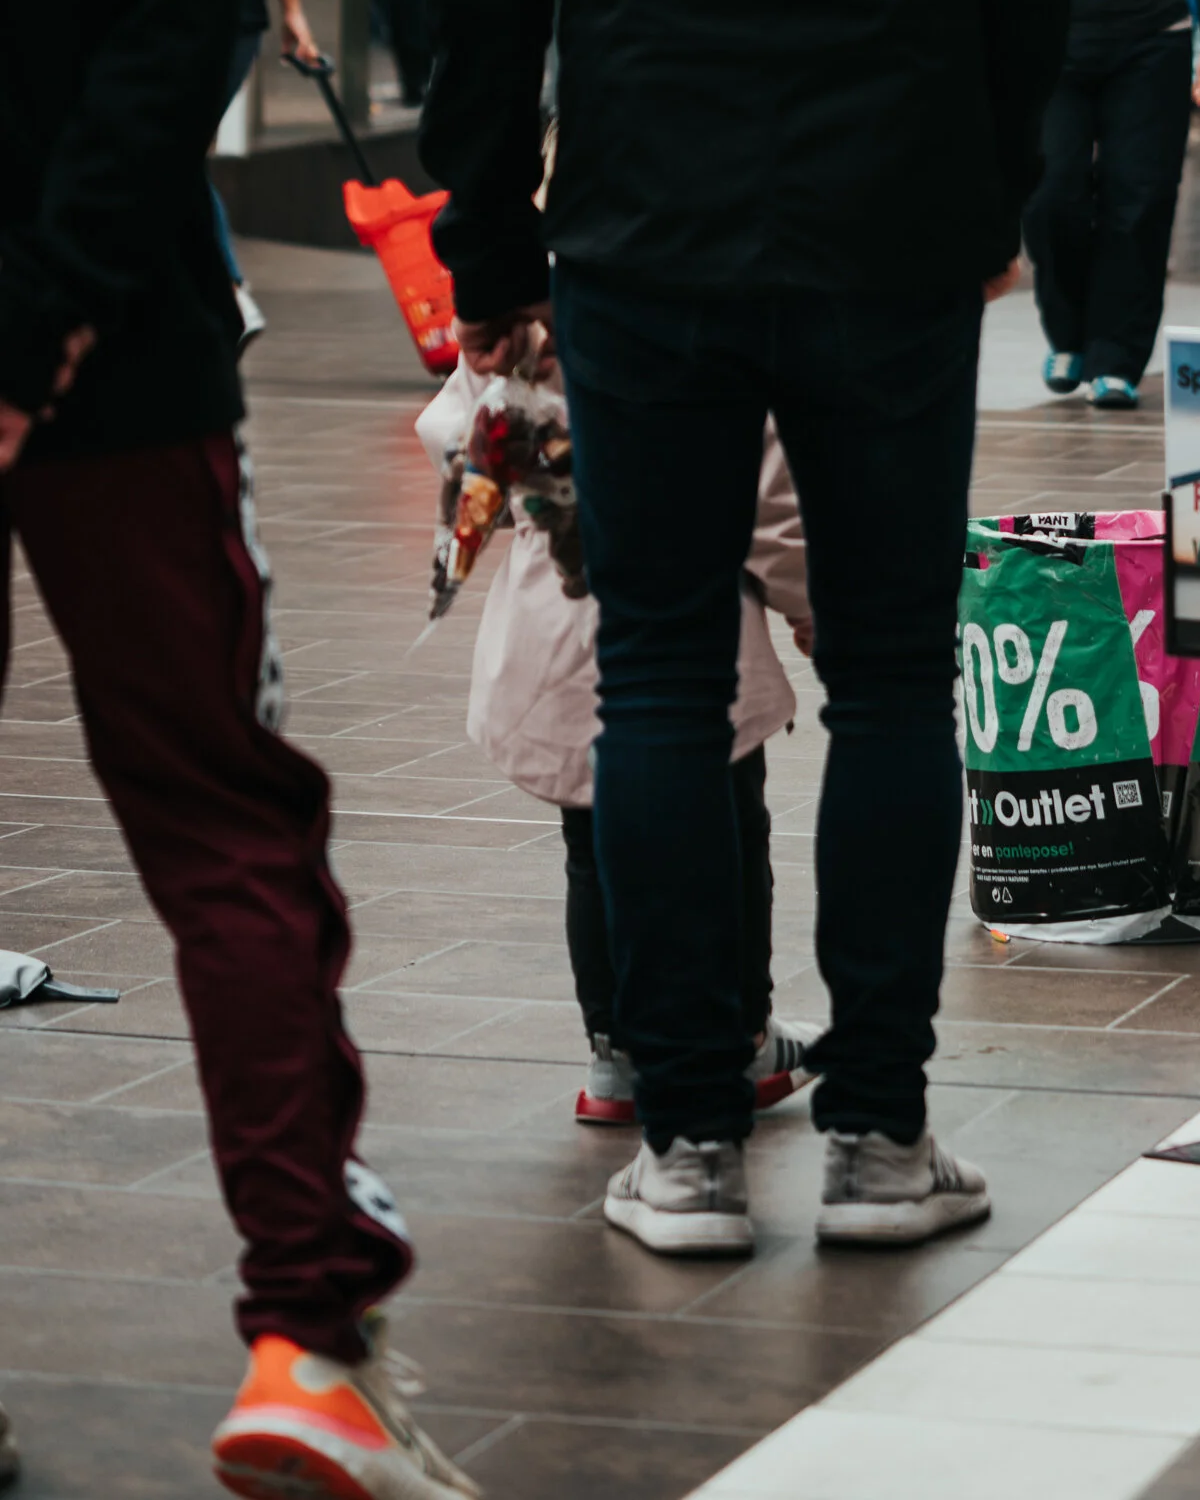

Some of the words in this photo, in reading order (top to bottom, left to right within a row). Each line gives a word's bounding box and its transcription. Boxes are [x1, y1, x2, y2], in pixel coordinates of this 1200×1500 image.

[1037, 514, 1070, 528] PANT
[956, 619, 1098, 754] 0%
[993, 783, 1106, 828] Outlet
[981, 844, 993, 859] en
[995, 840, 1076, 862] pantepose!
